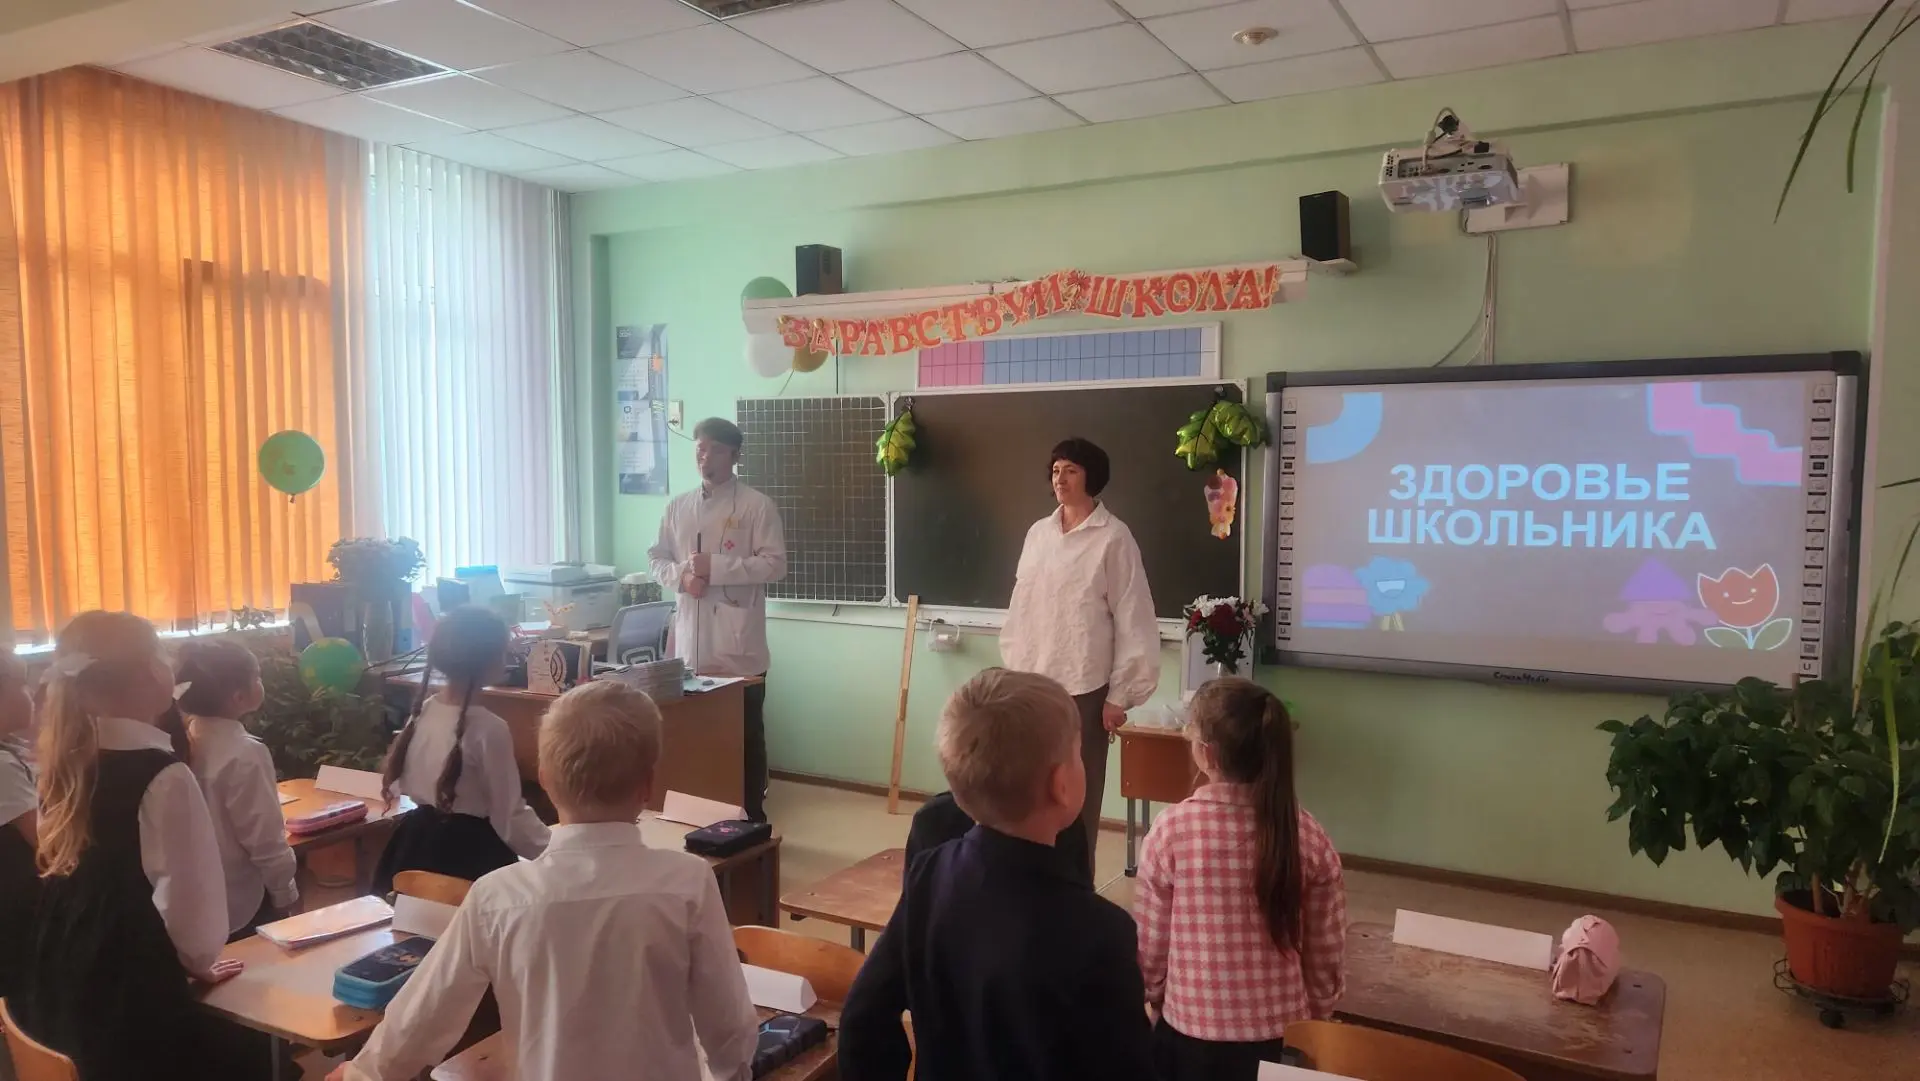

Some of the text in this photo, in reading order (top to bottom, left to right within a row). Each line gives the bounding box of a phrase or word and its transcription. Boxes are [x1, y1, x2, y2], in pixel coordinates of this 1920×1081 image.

[1083, 264, 1276, 319] ШКОЛА!
[1389, 463, 1691, 507] ЗДОРОВЬЕ
[1367, 509, 1717, 550] ШКОЛЬНИКА
